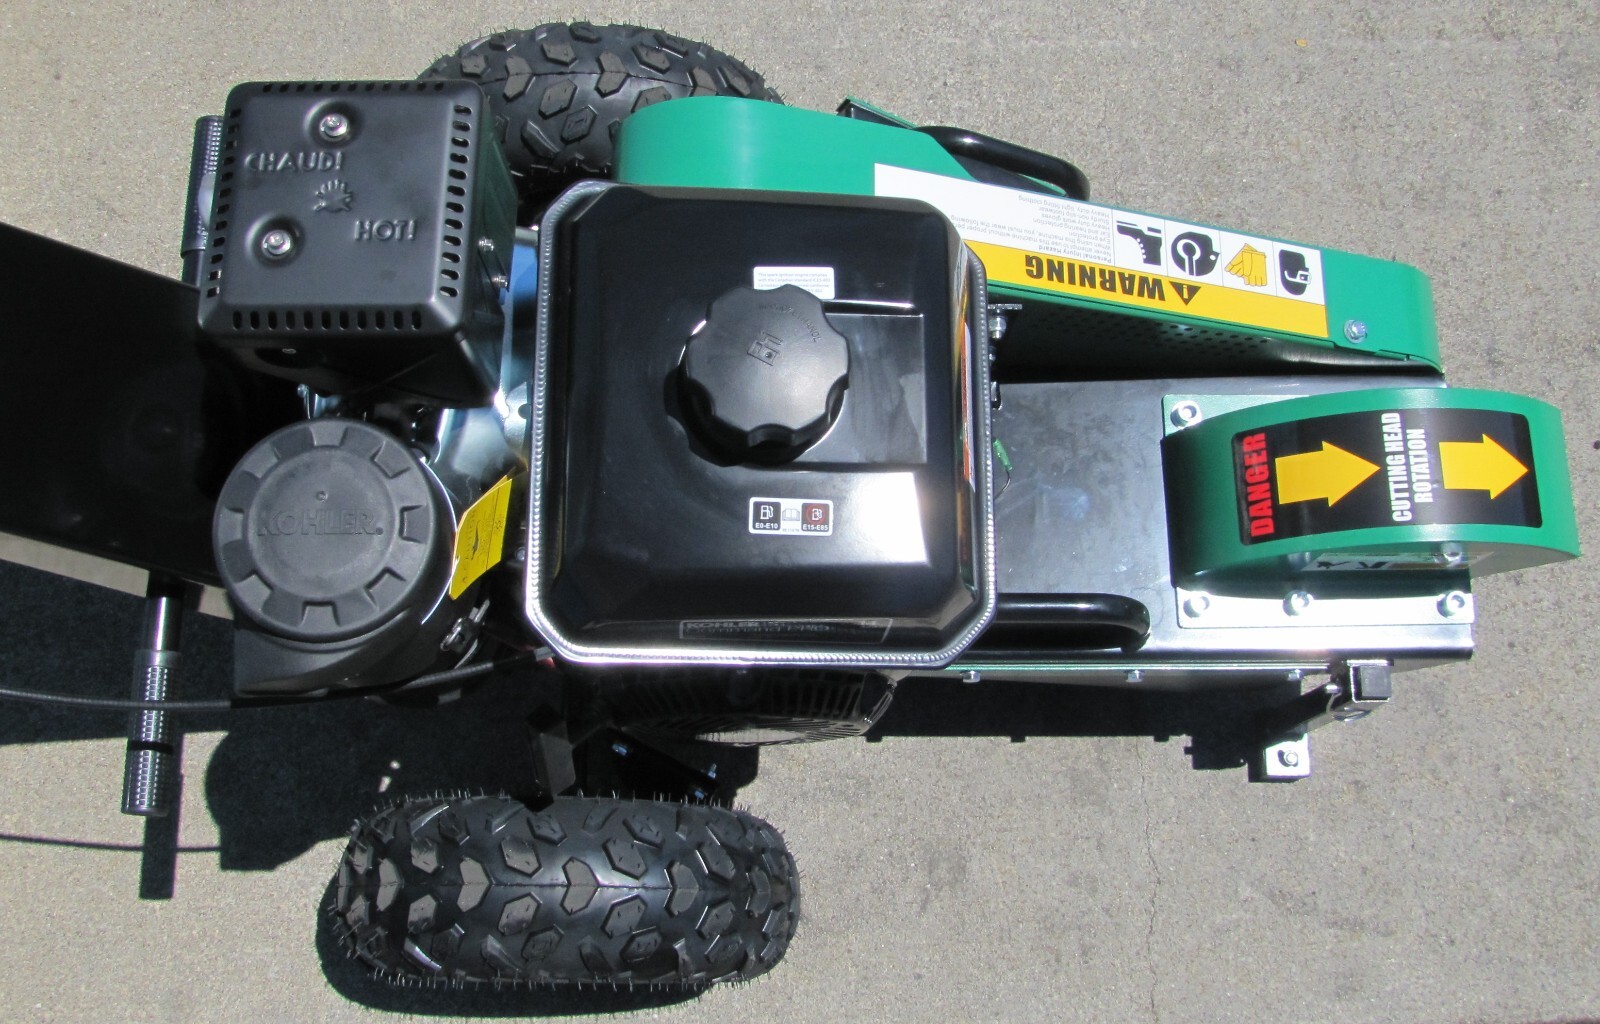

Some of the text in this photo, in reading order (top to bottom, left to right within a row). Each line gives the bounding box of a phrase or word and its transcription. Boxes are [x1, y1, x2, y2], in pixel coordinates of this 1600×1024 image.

[244, 151, 343, 171] CHAUD!
[1038, 205, 1064, 216] footwear
[1041, 212, 1061, 221] gloves
[1090, 215, 1109, 225] Sturdy
[1032, 217, 1063, 228] protection
[1077, 219, 1090, 227] duty
[1092, 222, 1109, 231] Heavy
[354, 219, 417, 241] HOT!
[966, 224, 986, 233] proper
[988, 229, 1010, 237] without
[1064, 223, 1086, 233] hearing
[1011, 233, 1037, 243] machine
[1068, 231, 1110, 244] Eye protection
[1076, 238, 1092, 246] using
[1070, 243, 1092, 252] attempt
[1094, 248, 1110, 256] Never
[1038, 245, 1111, 263] Personal Injury Hazard
[1025, 254, 1166, 301] WARNING
[1381, 412, 1412, 522] CUTTING HEAD
[1406, 429, 1433, 503] ROTATION
[1243, 432, 1275, 537] DANGER
